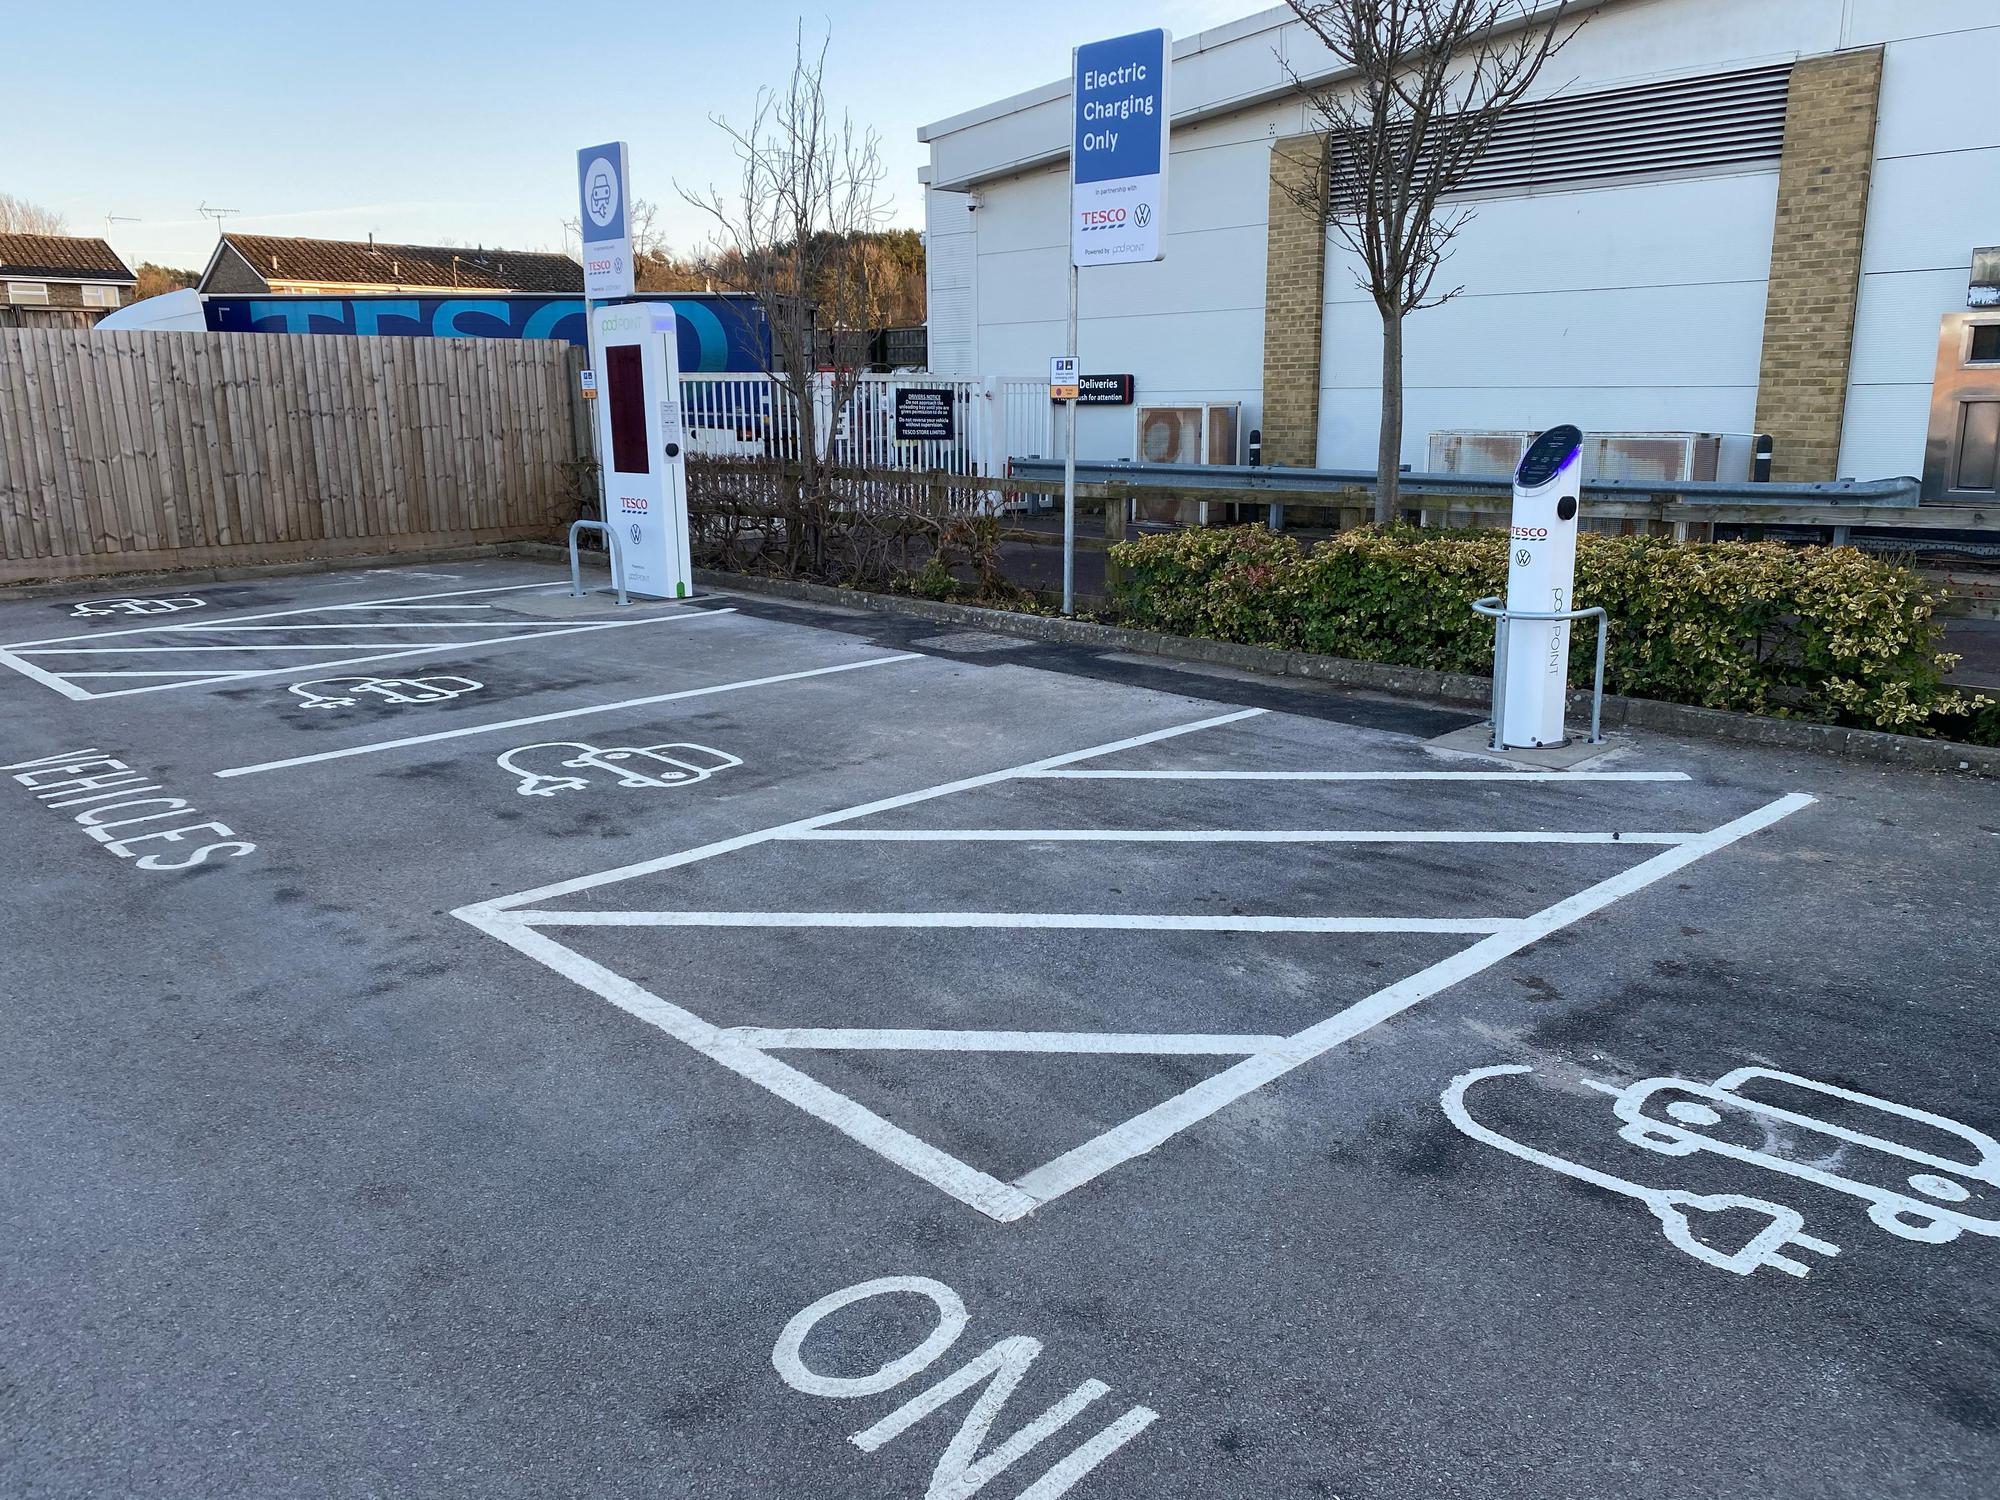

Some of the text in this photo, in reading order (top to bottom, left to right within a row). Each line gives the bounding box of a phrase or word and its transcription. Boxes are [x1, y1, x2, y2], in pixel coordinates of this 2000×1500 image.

[1084, 62, 1147, 91] Electric
[1083, 94, 1154, 120] Charging
[1083, 129, 1119, 152] Only
[1100, 186, 1127, 196] partnership
[1081, 208, 1127, 225] TESCO
[588, 260, 611, 271] TESCO
[1079, 378, 1118, 389] Deliveries
[1088, 393, 1097, 401] for
[620, 497, 648, 510] TESCO
[1511, 527, 1548, 537] TESCO
[0, 747, 257, 871] VEHICLES
